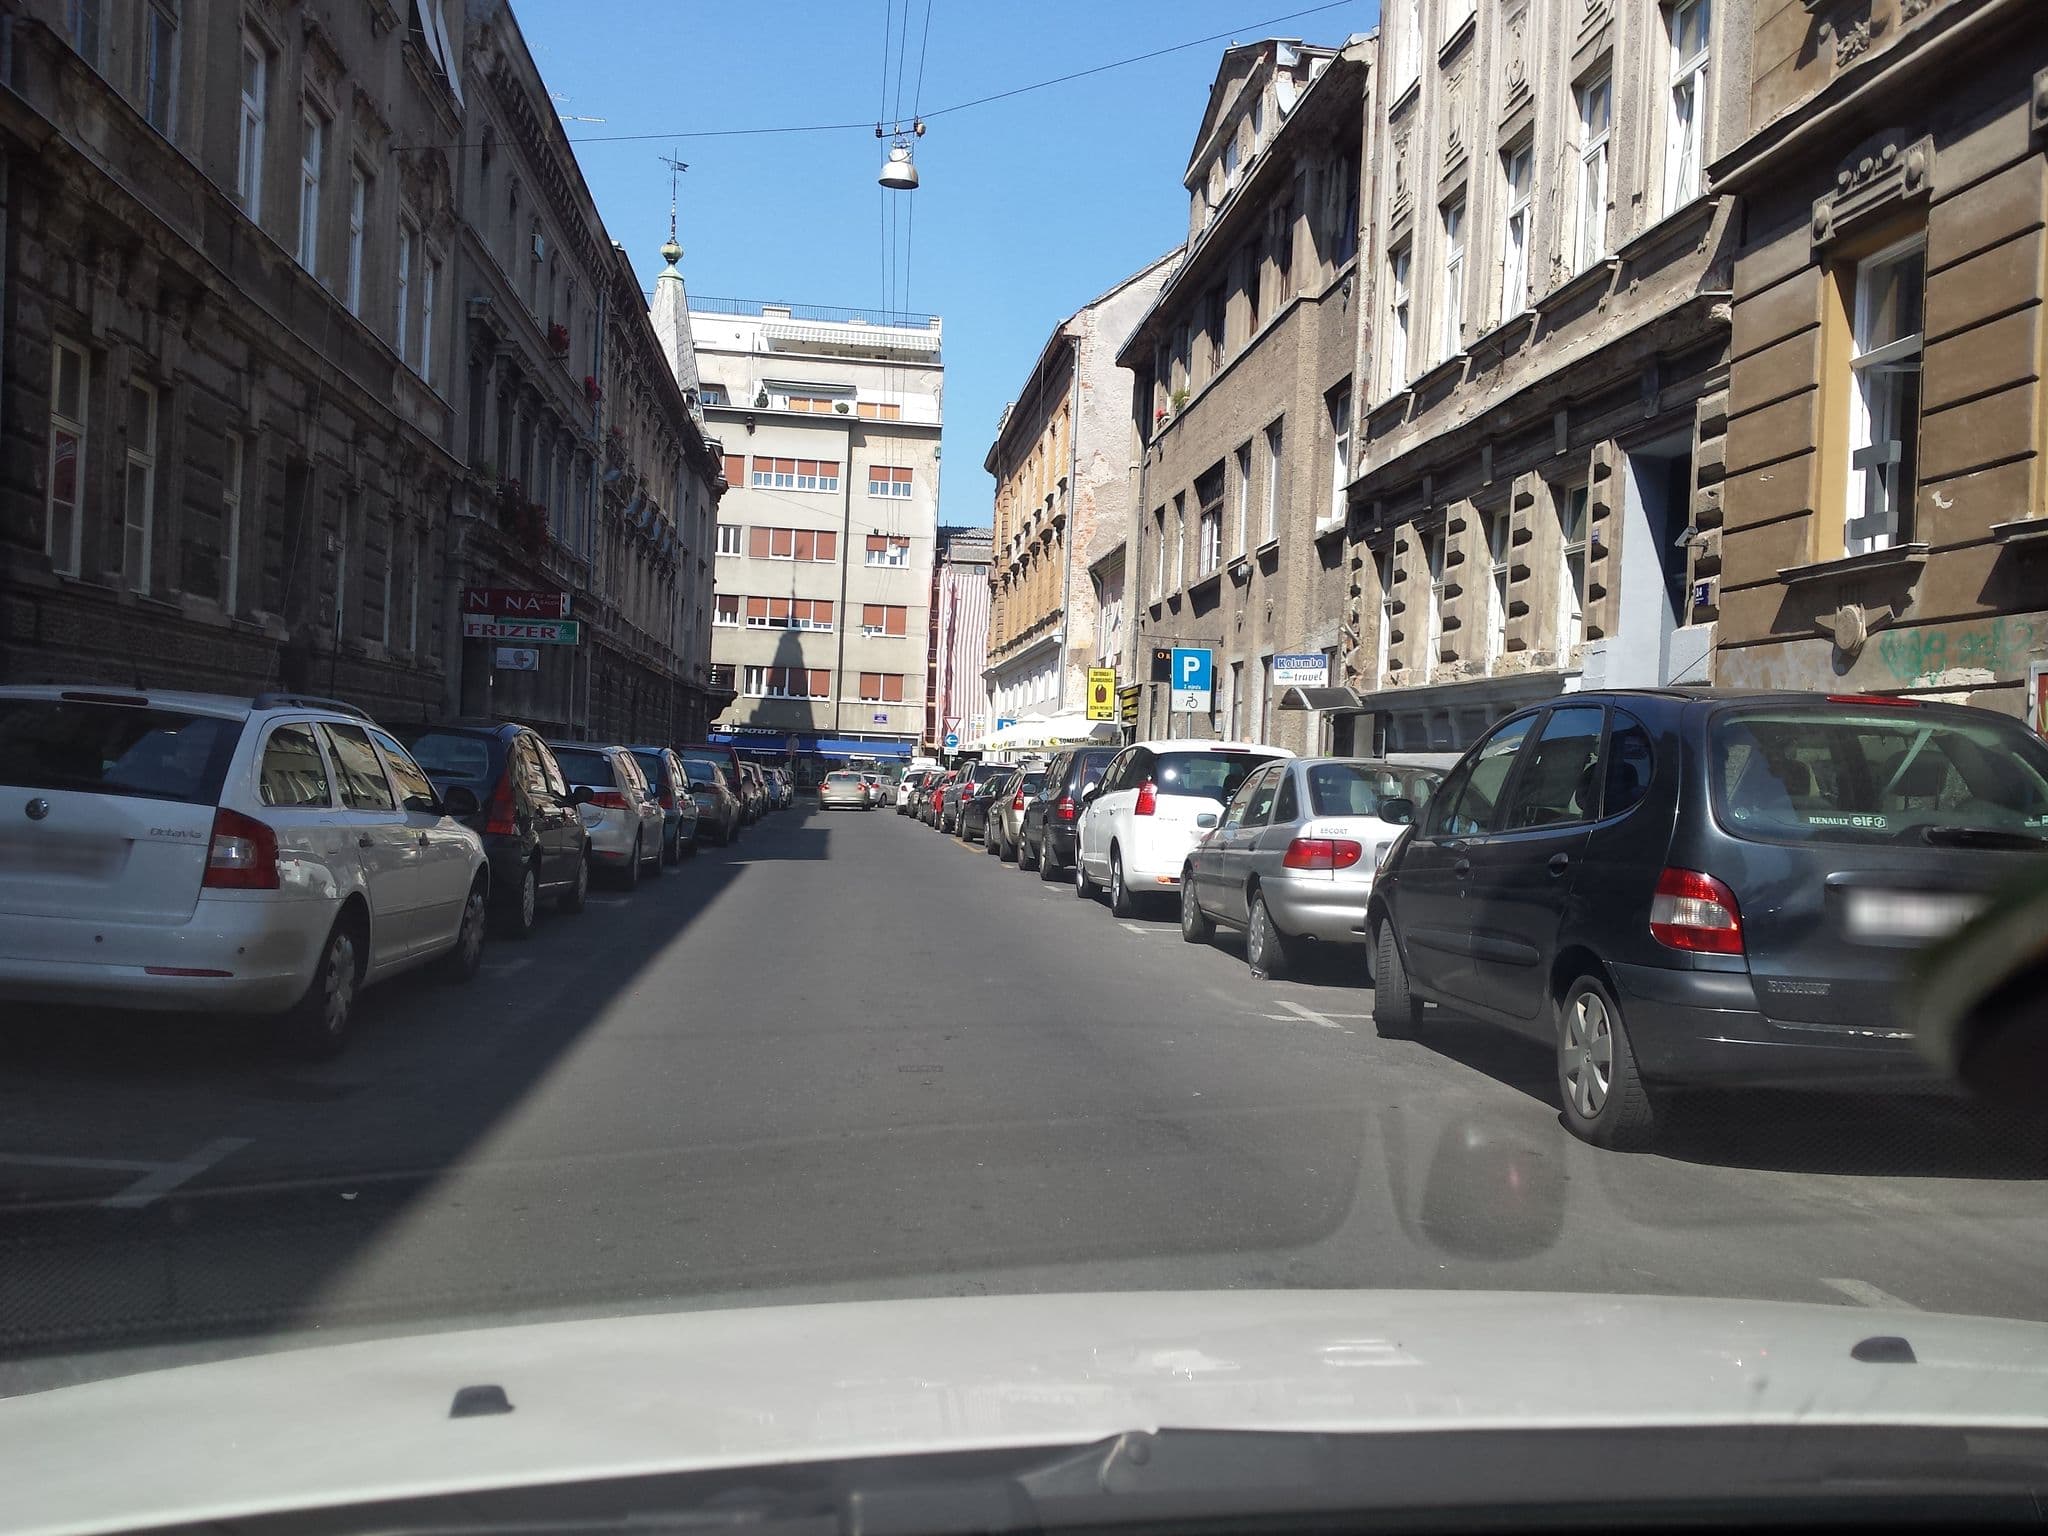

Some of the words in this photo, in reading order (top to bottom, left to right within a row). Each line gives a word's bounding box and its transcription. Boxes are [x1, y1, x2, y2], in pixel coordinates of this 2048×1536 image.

[468, 624, 556, 638] FRIZER
[1183, 656, 1201, 682] P
[1277, 657, 1324, 669] Kolumbo
[1294, 670, 1323, 681] travel
[1808, 816, 1849, 826] RENAULT
